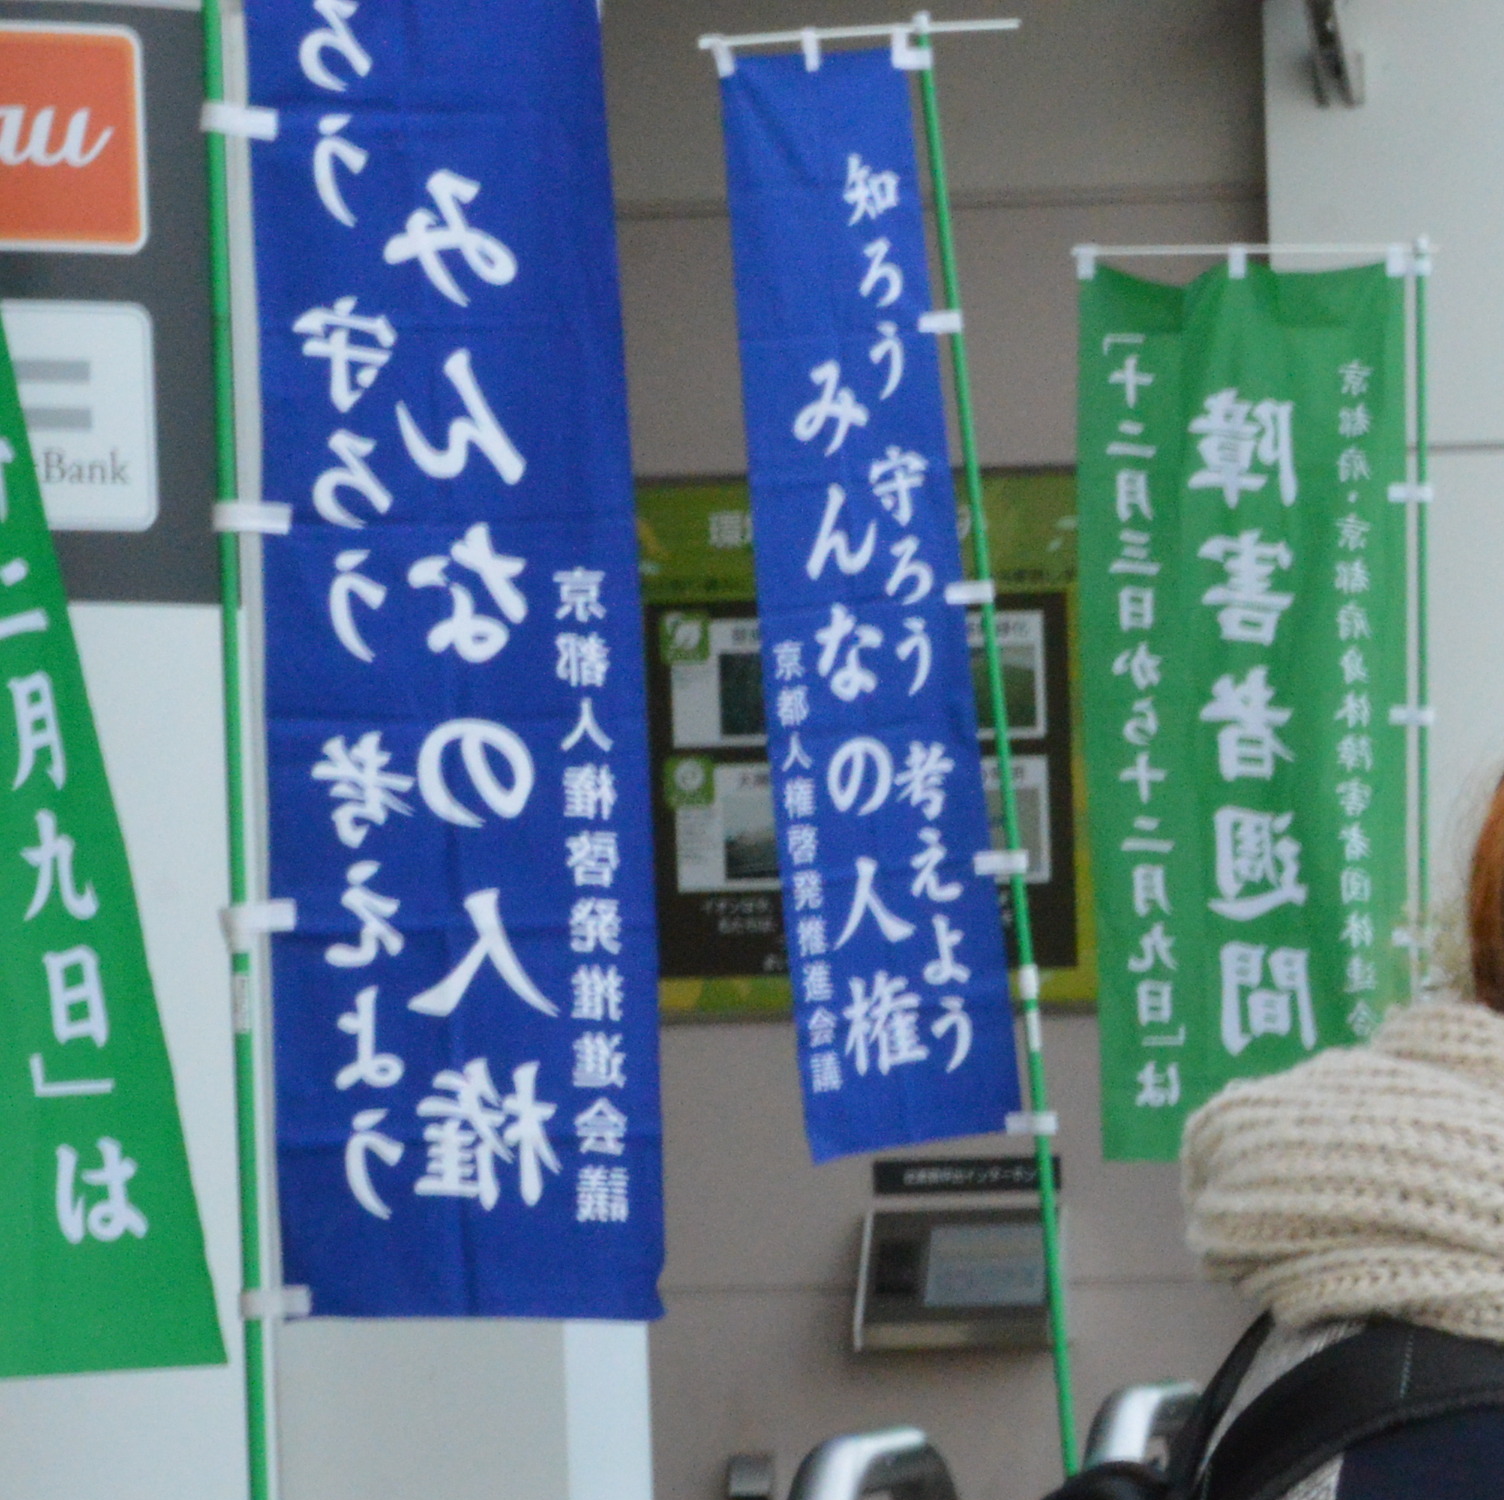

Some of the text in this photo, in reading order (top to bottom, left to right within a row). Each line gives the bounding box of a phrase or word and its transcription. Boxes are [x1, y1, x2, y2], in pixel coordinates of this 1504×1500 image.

[35, 447, 130, 485] Bank
[793, 360, 930, 1077] みんなの人権
